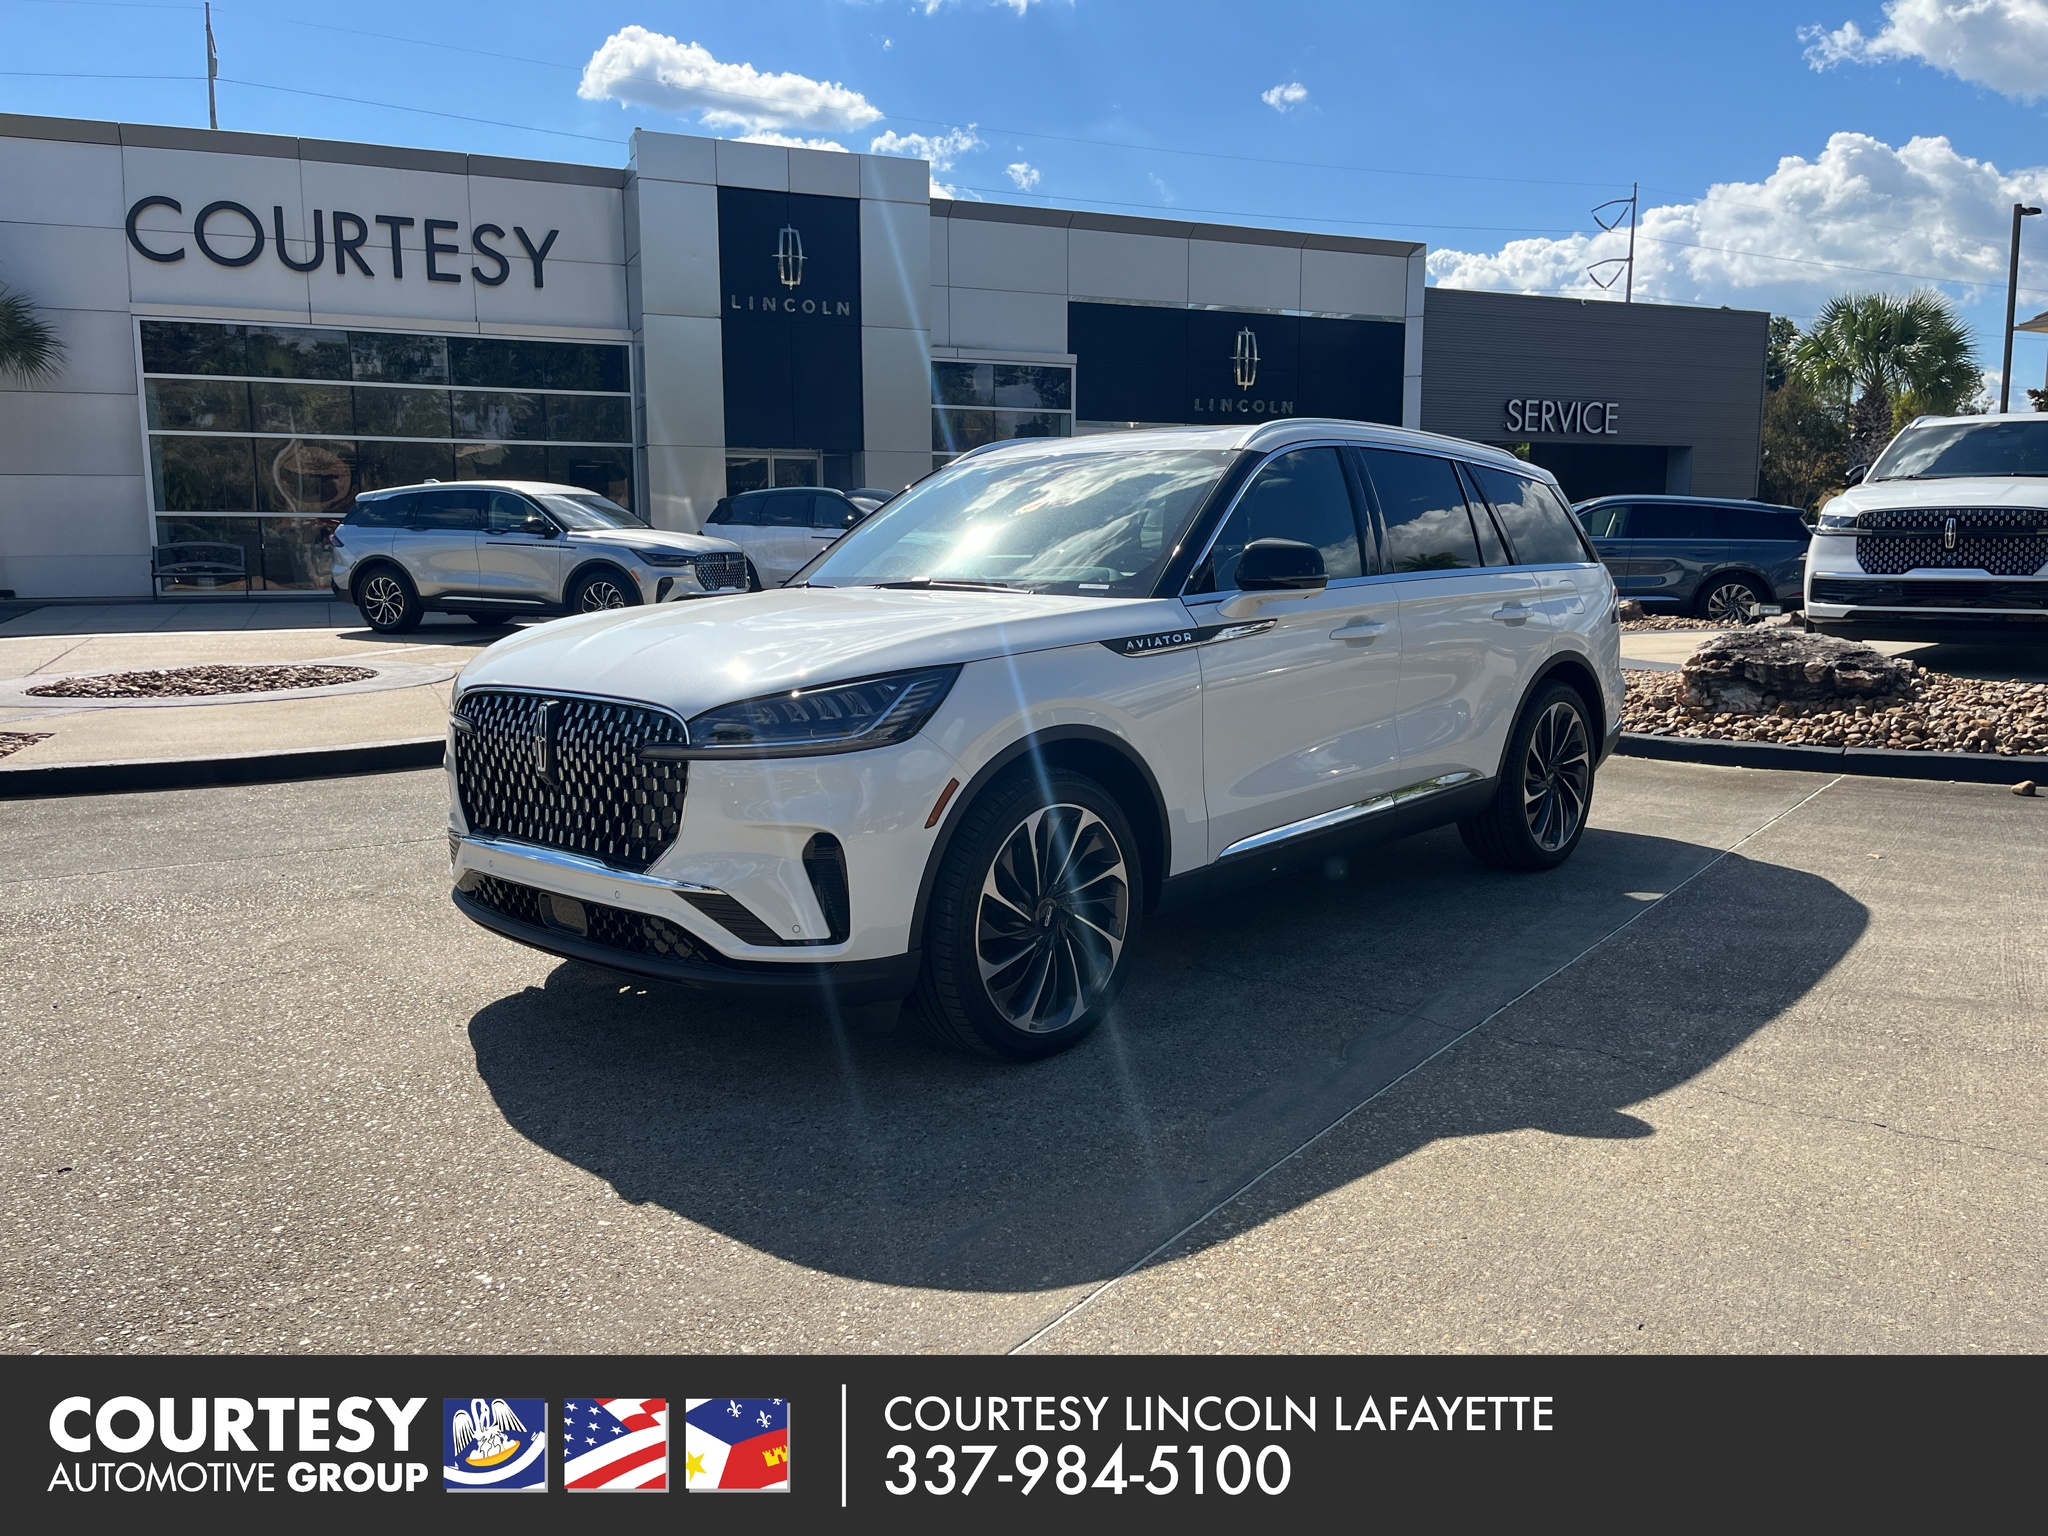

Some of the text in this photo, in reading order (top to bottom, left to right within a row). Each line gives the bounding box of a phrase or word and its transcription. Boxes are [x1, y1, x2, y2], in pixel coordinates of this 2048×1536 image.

[125, 195, 560, 288] COURTESY
[731, 294, 850, 316] LINCOLN
[1194, 398, 1294, 414] LINCOLN
[1506, 398, 1619, 434] SERVICE
[1126, 632, 1192, 650] AVIATOR
